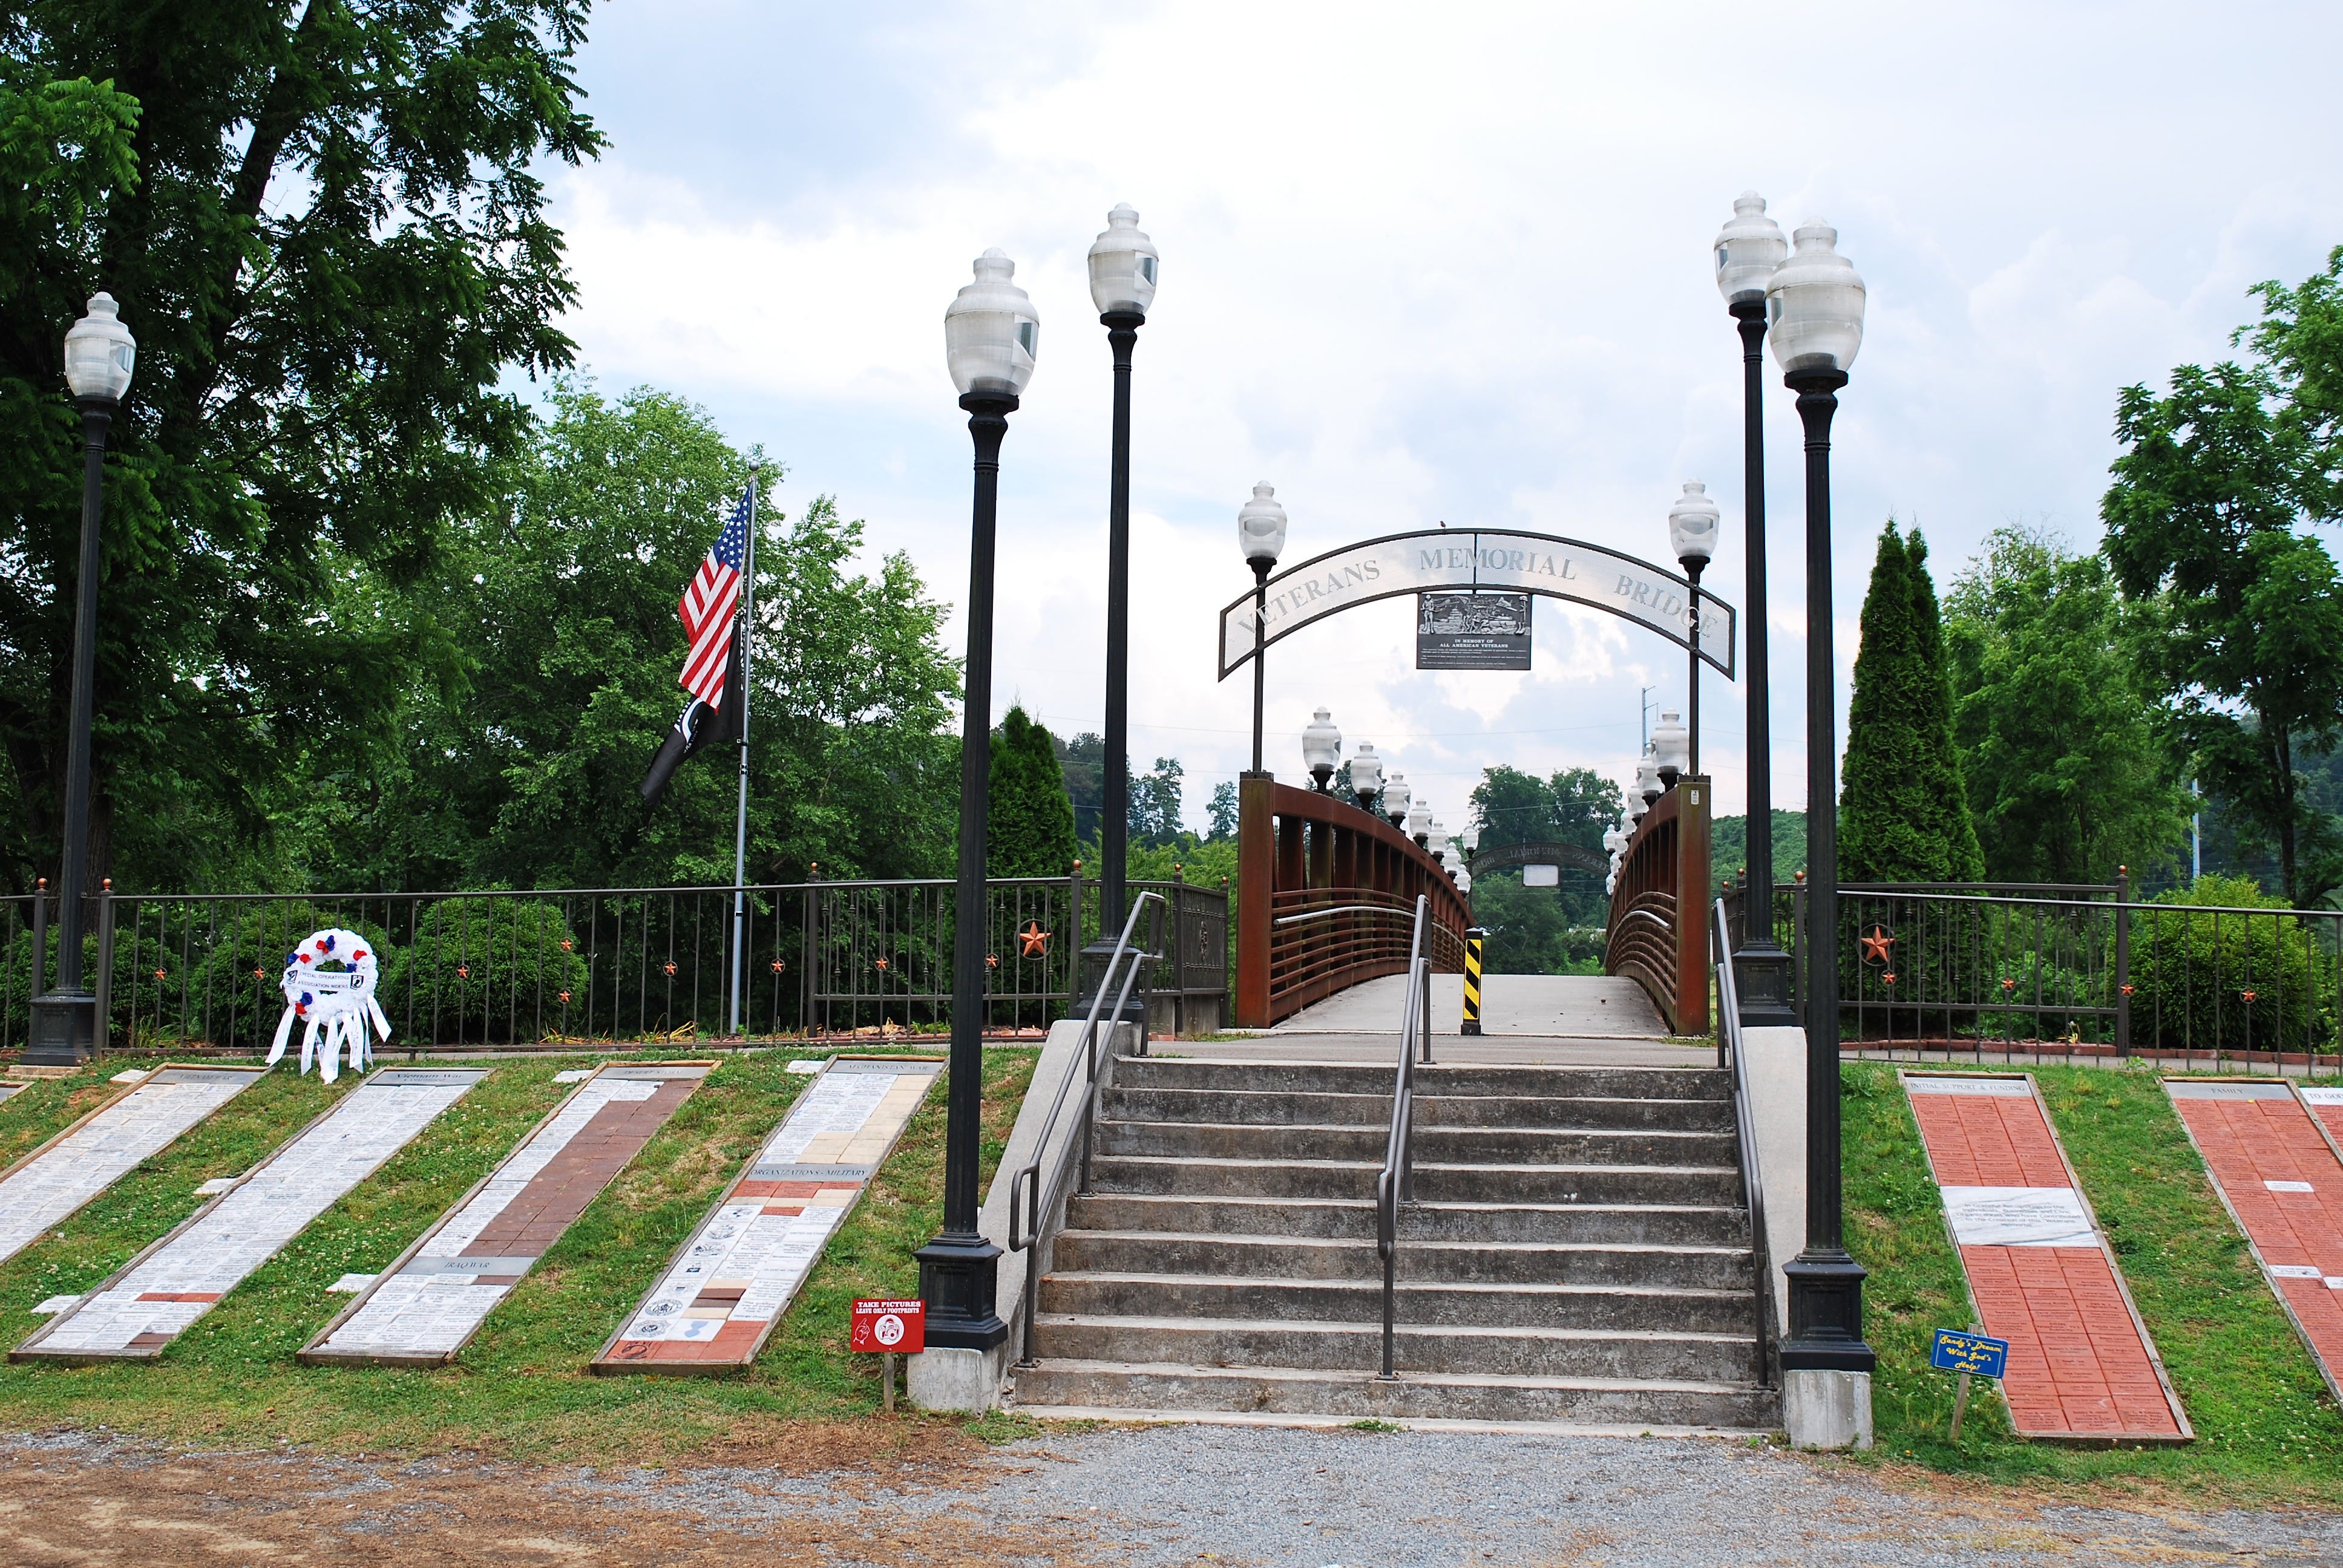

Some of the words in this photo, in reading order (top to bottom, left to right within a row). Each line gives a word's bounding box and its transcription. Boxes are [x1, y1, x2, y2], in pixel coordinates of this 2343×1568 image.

[1237, 560, 1380, 633] VETERANS
[1420, 547, 1577, 580] MEMORIAL
[1614, 575, 1718, 638] BRIDGE
[1940, 1336, 1971, 1348] Sandy's
[1971, 1341, 2001, 1352] Dream
[1946, 1347, 1967, 1357] With
[1968, 1352, 1991, 1361] God's
[1955, 1361, 1981, 1372] Help!
